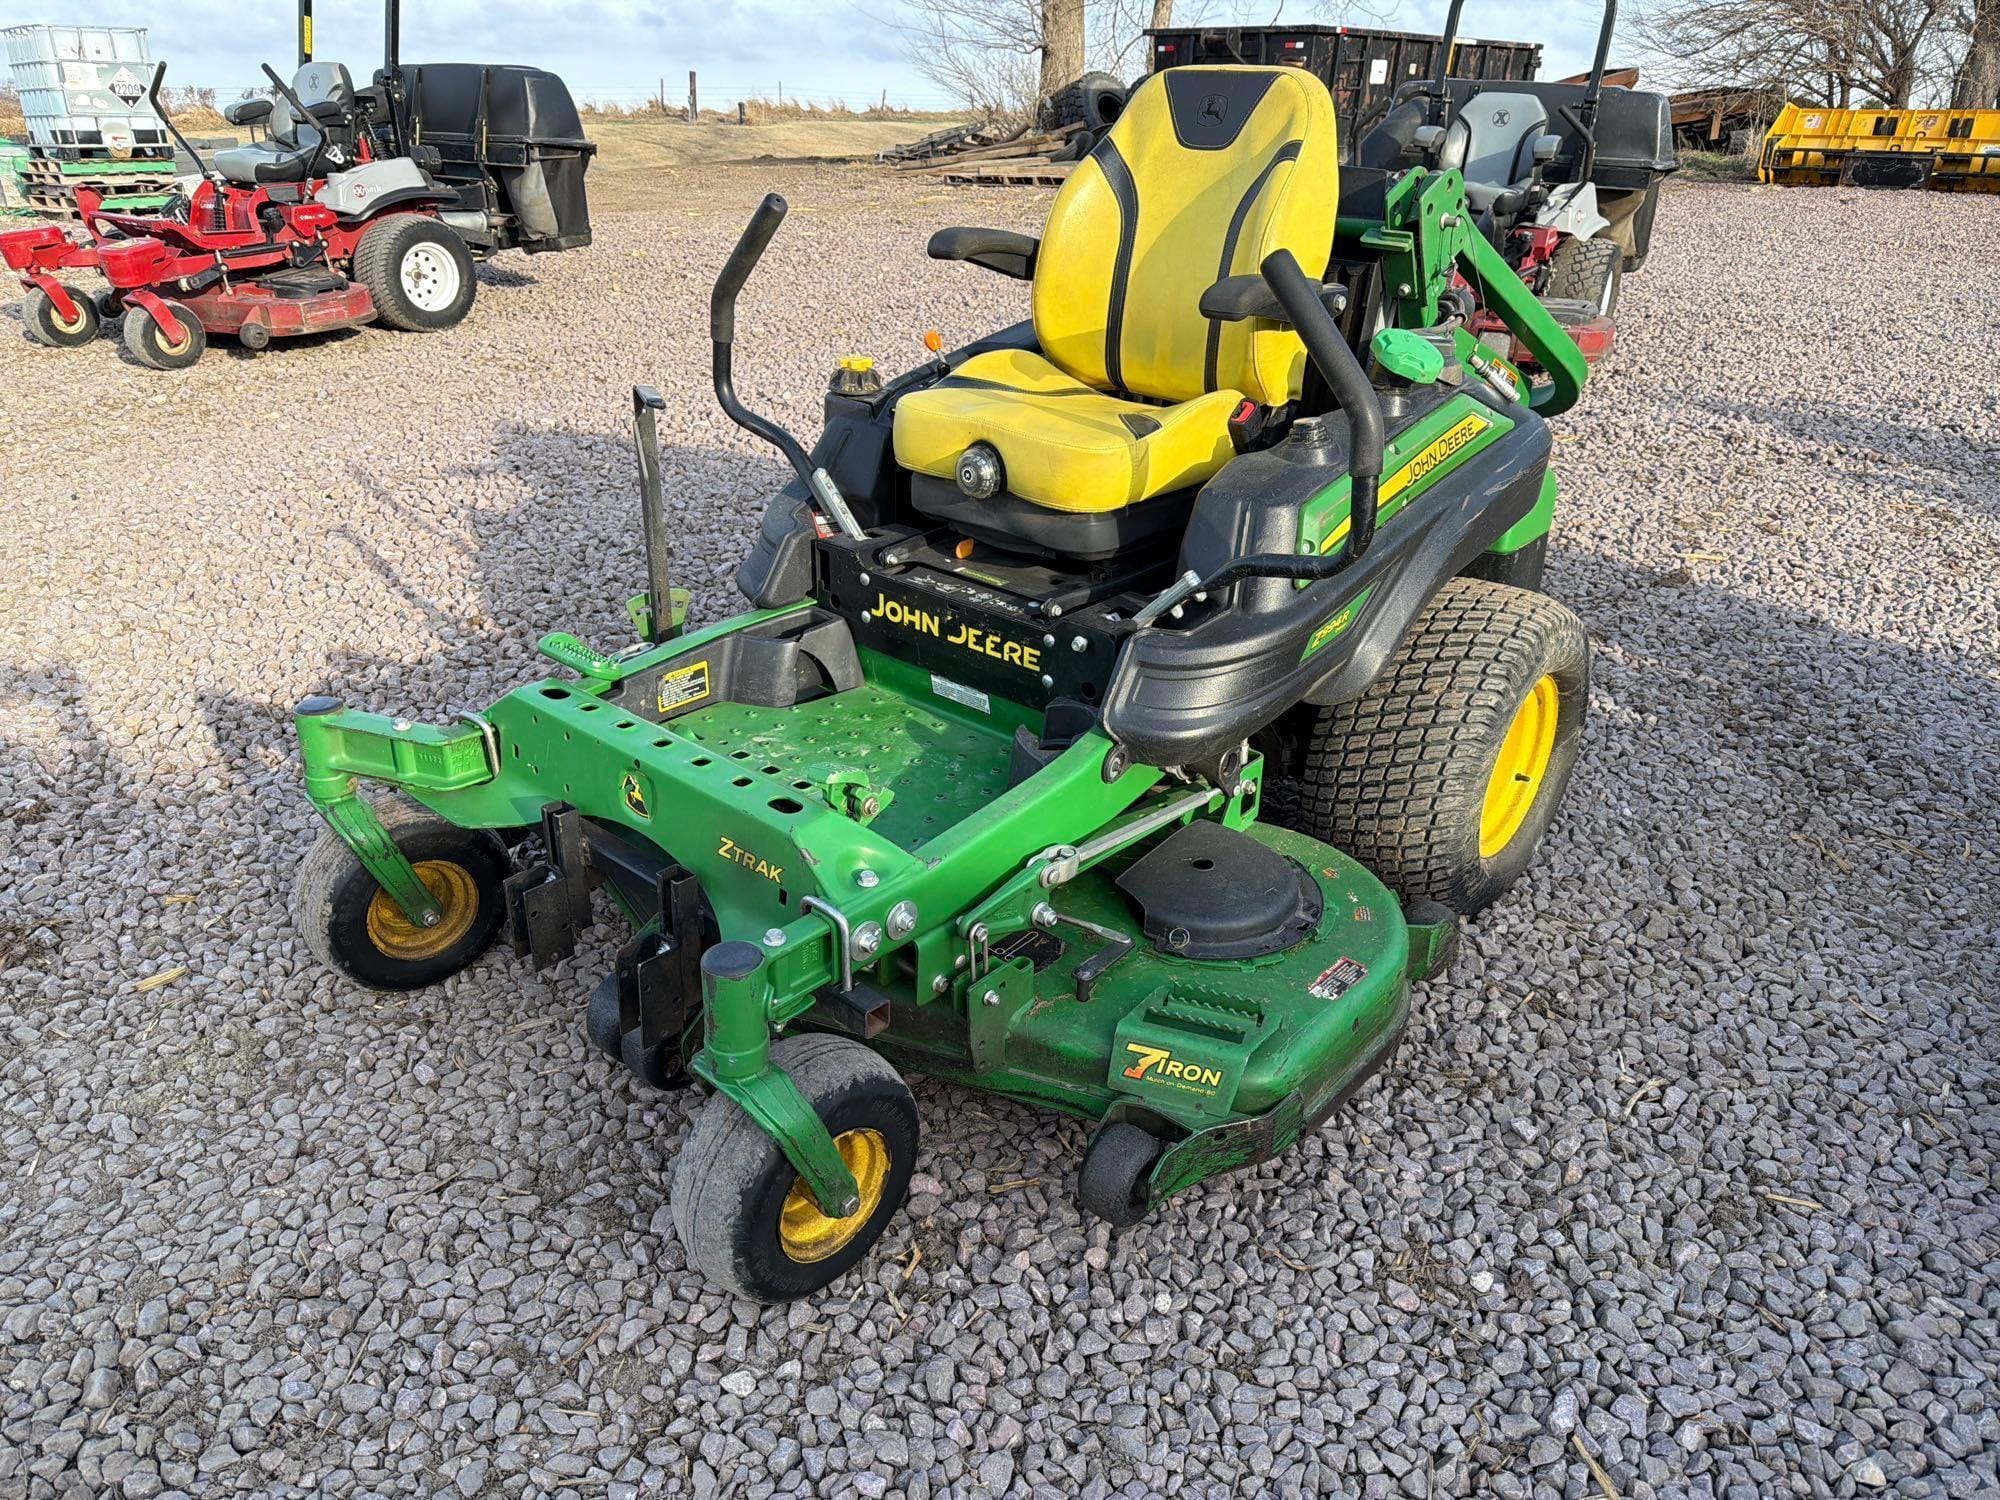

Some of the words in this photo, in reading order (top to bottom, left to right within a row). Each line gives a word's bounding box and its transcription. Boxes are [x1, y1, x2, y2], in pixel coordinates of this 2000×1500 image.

[116, 84, 140, 95] 2209
[1407, 449, 1438, 484] JOHN
[1439, 421, 1475, 458] DEERE
[871, 592, 940, 638] JOHN
[718, 835, 784, 884] ZTRAK
[1146, 1075, 1166, 1085] Mulch
[1176, 1082, 1205, 1094] Demand
